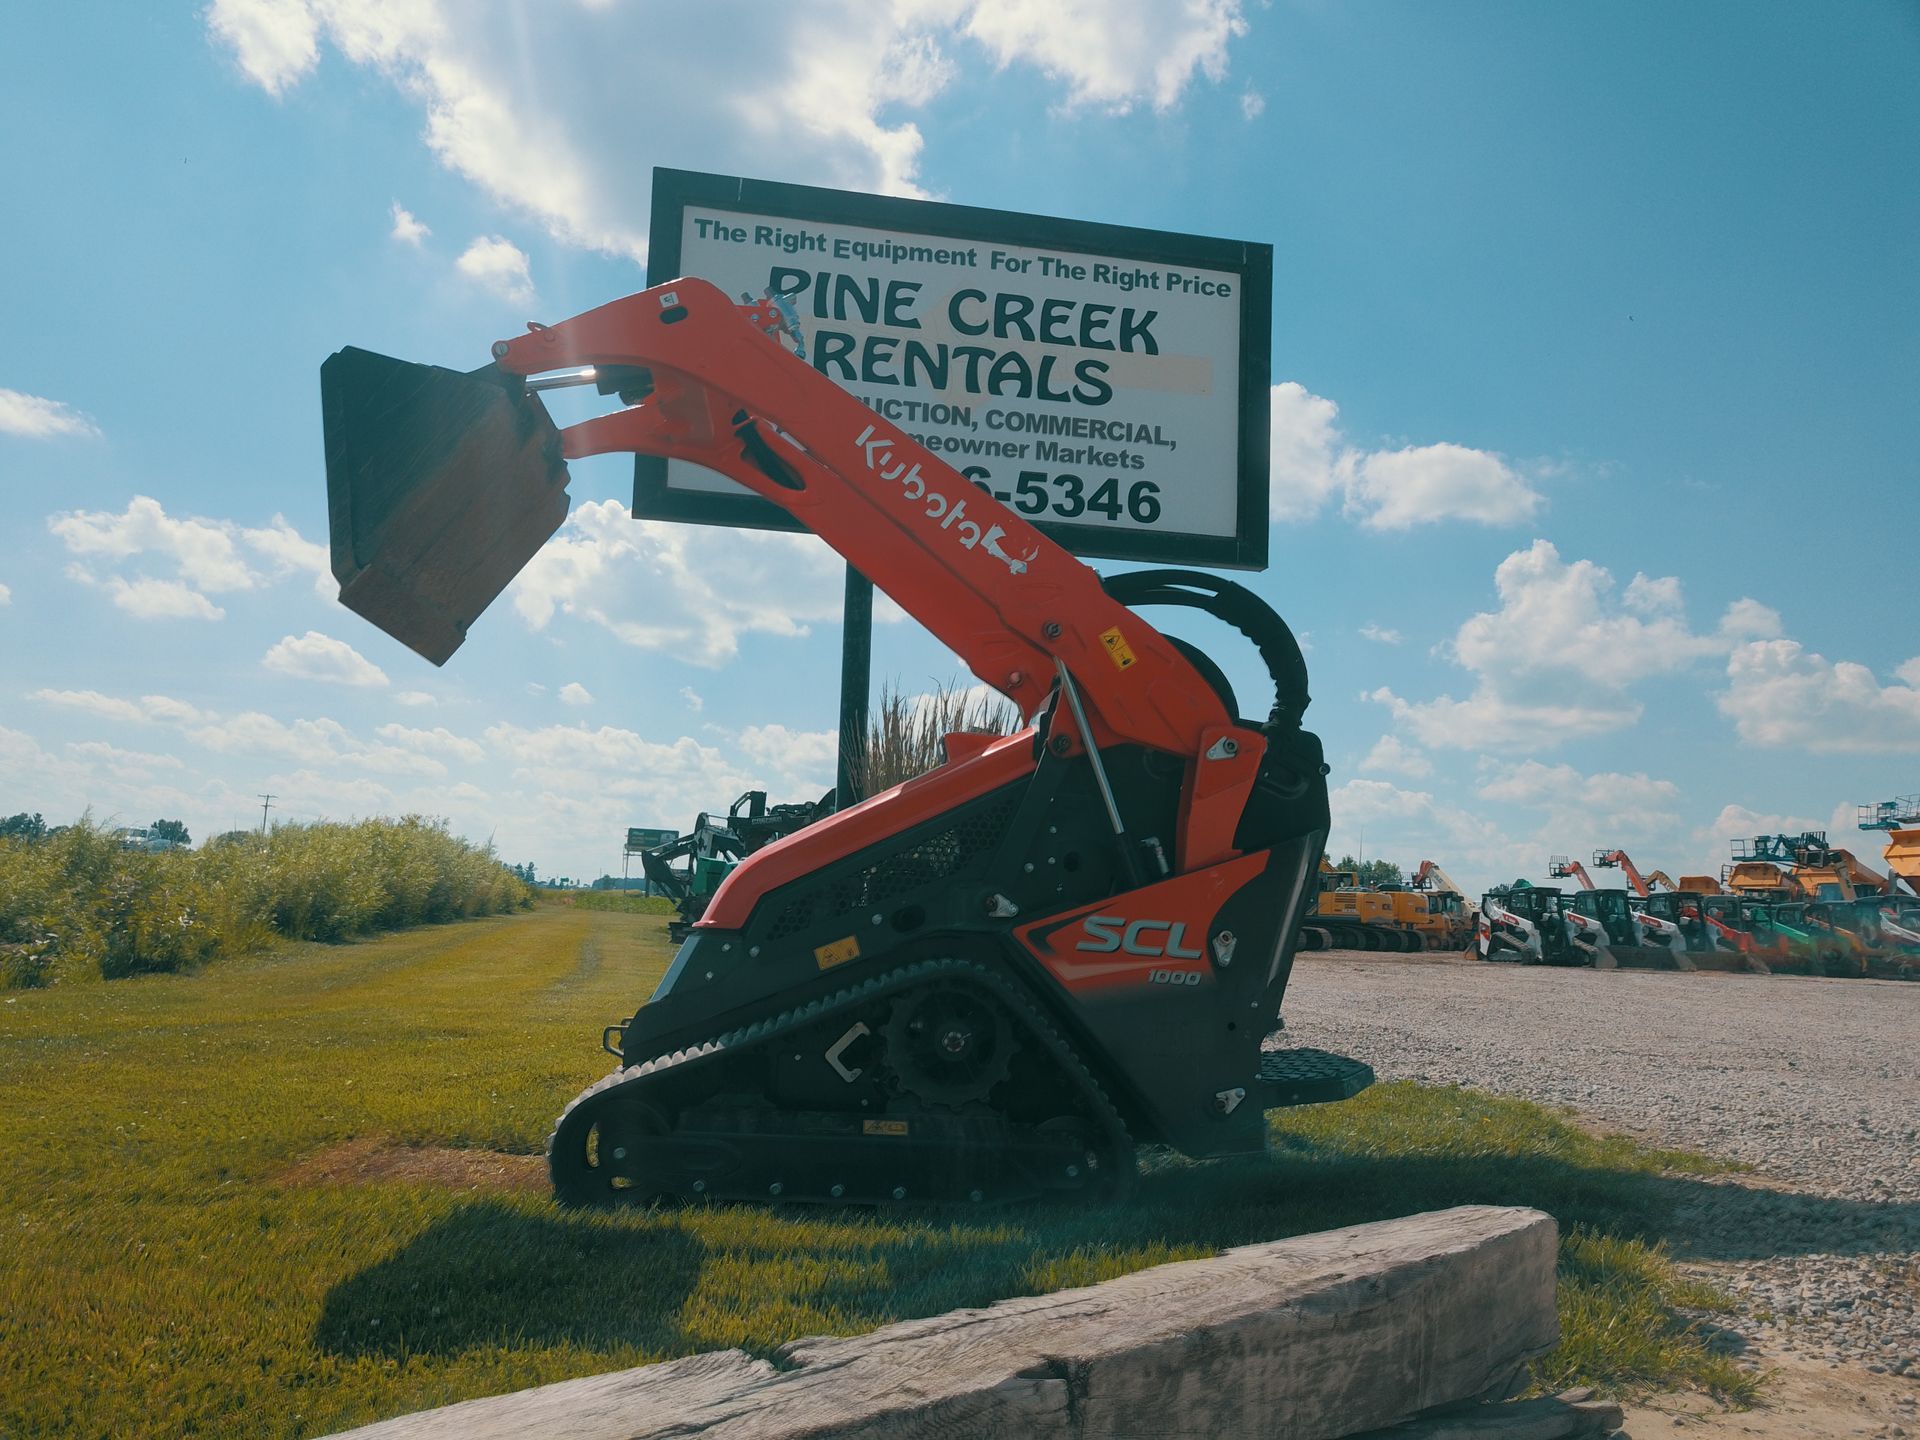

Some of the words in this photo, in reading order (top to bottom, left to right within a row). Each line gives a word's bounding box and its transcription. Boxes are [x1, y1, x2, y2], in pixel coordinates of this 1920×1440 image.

[694, 218, 748, 243] The
[754, 225, 827, 254] Right
[833, 238, 977, 268] Equipment
[990, 250, 1032, 274] For
[1038, 256, 1087, 281] The
[1093, 263, 1160, 292] Right
[1166, 272, 1232, 298] Price
[948, 288, 1159, 355] CREEK
[813, 330, 1113, 406] RENTALS
[857, 396, 978, 432] UCTION,
[985, 409, 1177, 451] COMMERCIAL,
[1035, 440, 1145, 470] Markets
[855, 424, 981, 550] Kubota
[1075, 916, 1202, 959] SCL
[1148, 969, 1202, 986] 1000
